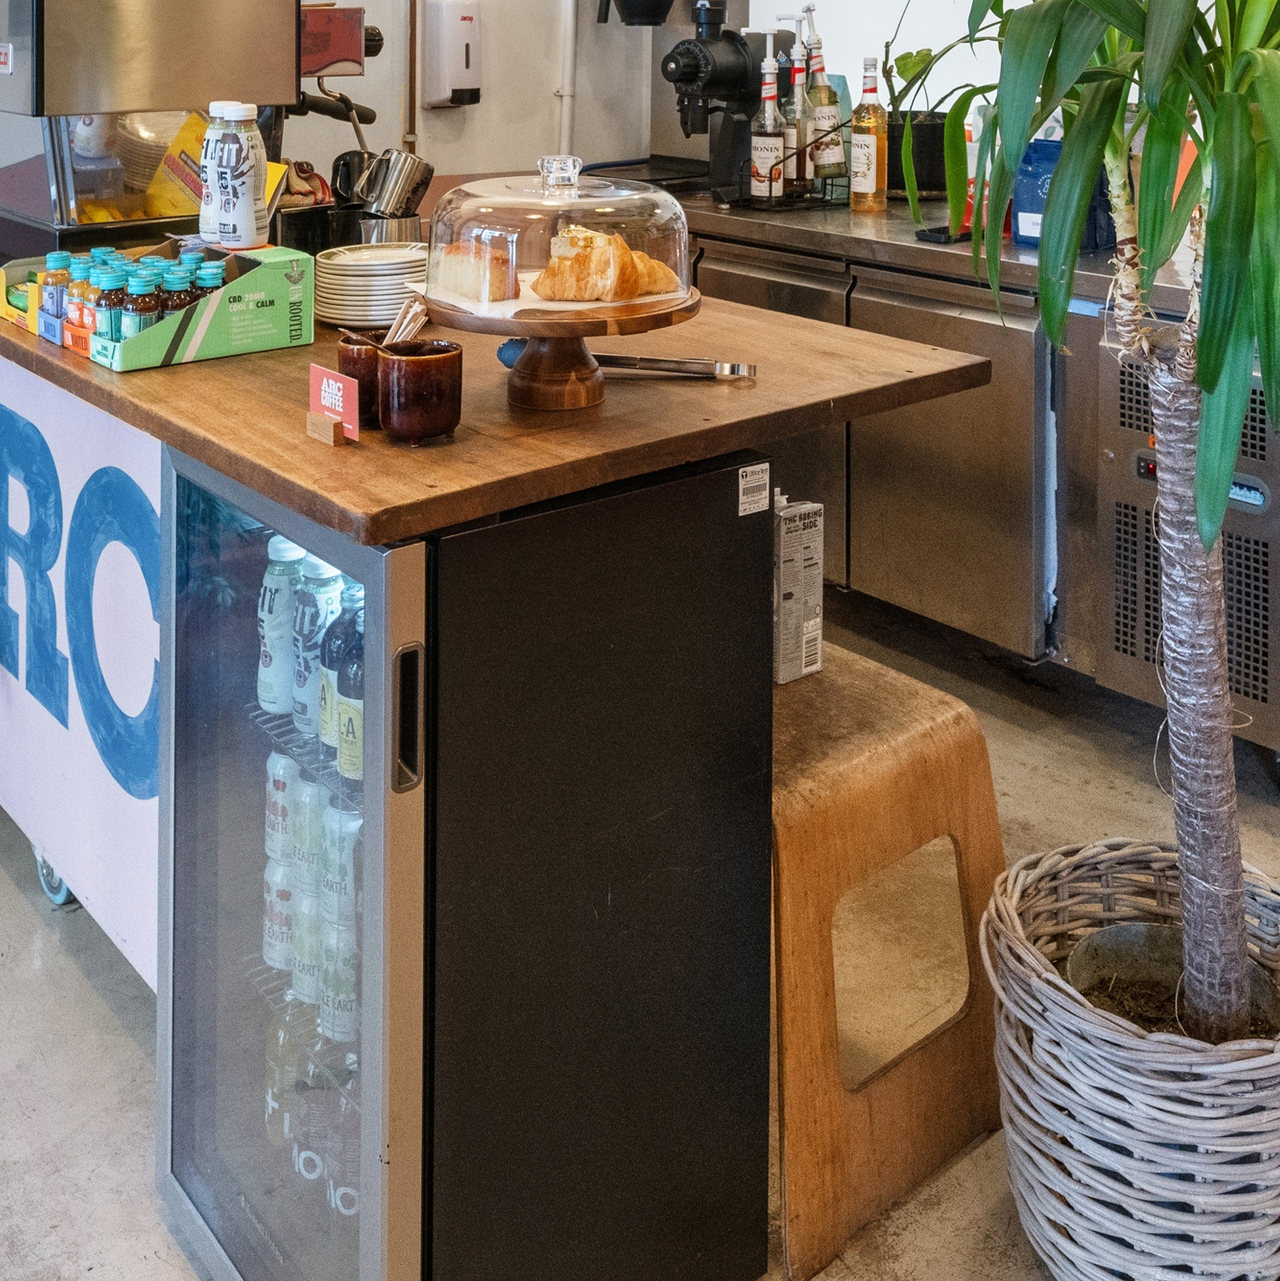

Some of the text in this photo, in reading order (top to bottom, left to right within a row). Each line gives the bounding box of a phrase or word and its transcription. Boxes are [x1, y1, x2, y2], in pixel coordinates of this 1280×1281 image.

[228, 294, 242, 303] CBD
[256, 300, 275, 308] CALM
[321, 378, 343, 396] ARC
[321, 391, 343, 412] COFFEE
[783, 515, 798, 526] THE
[802, 520, 818, 531] SIDE
